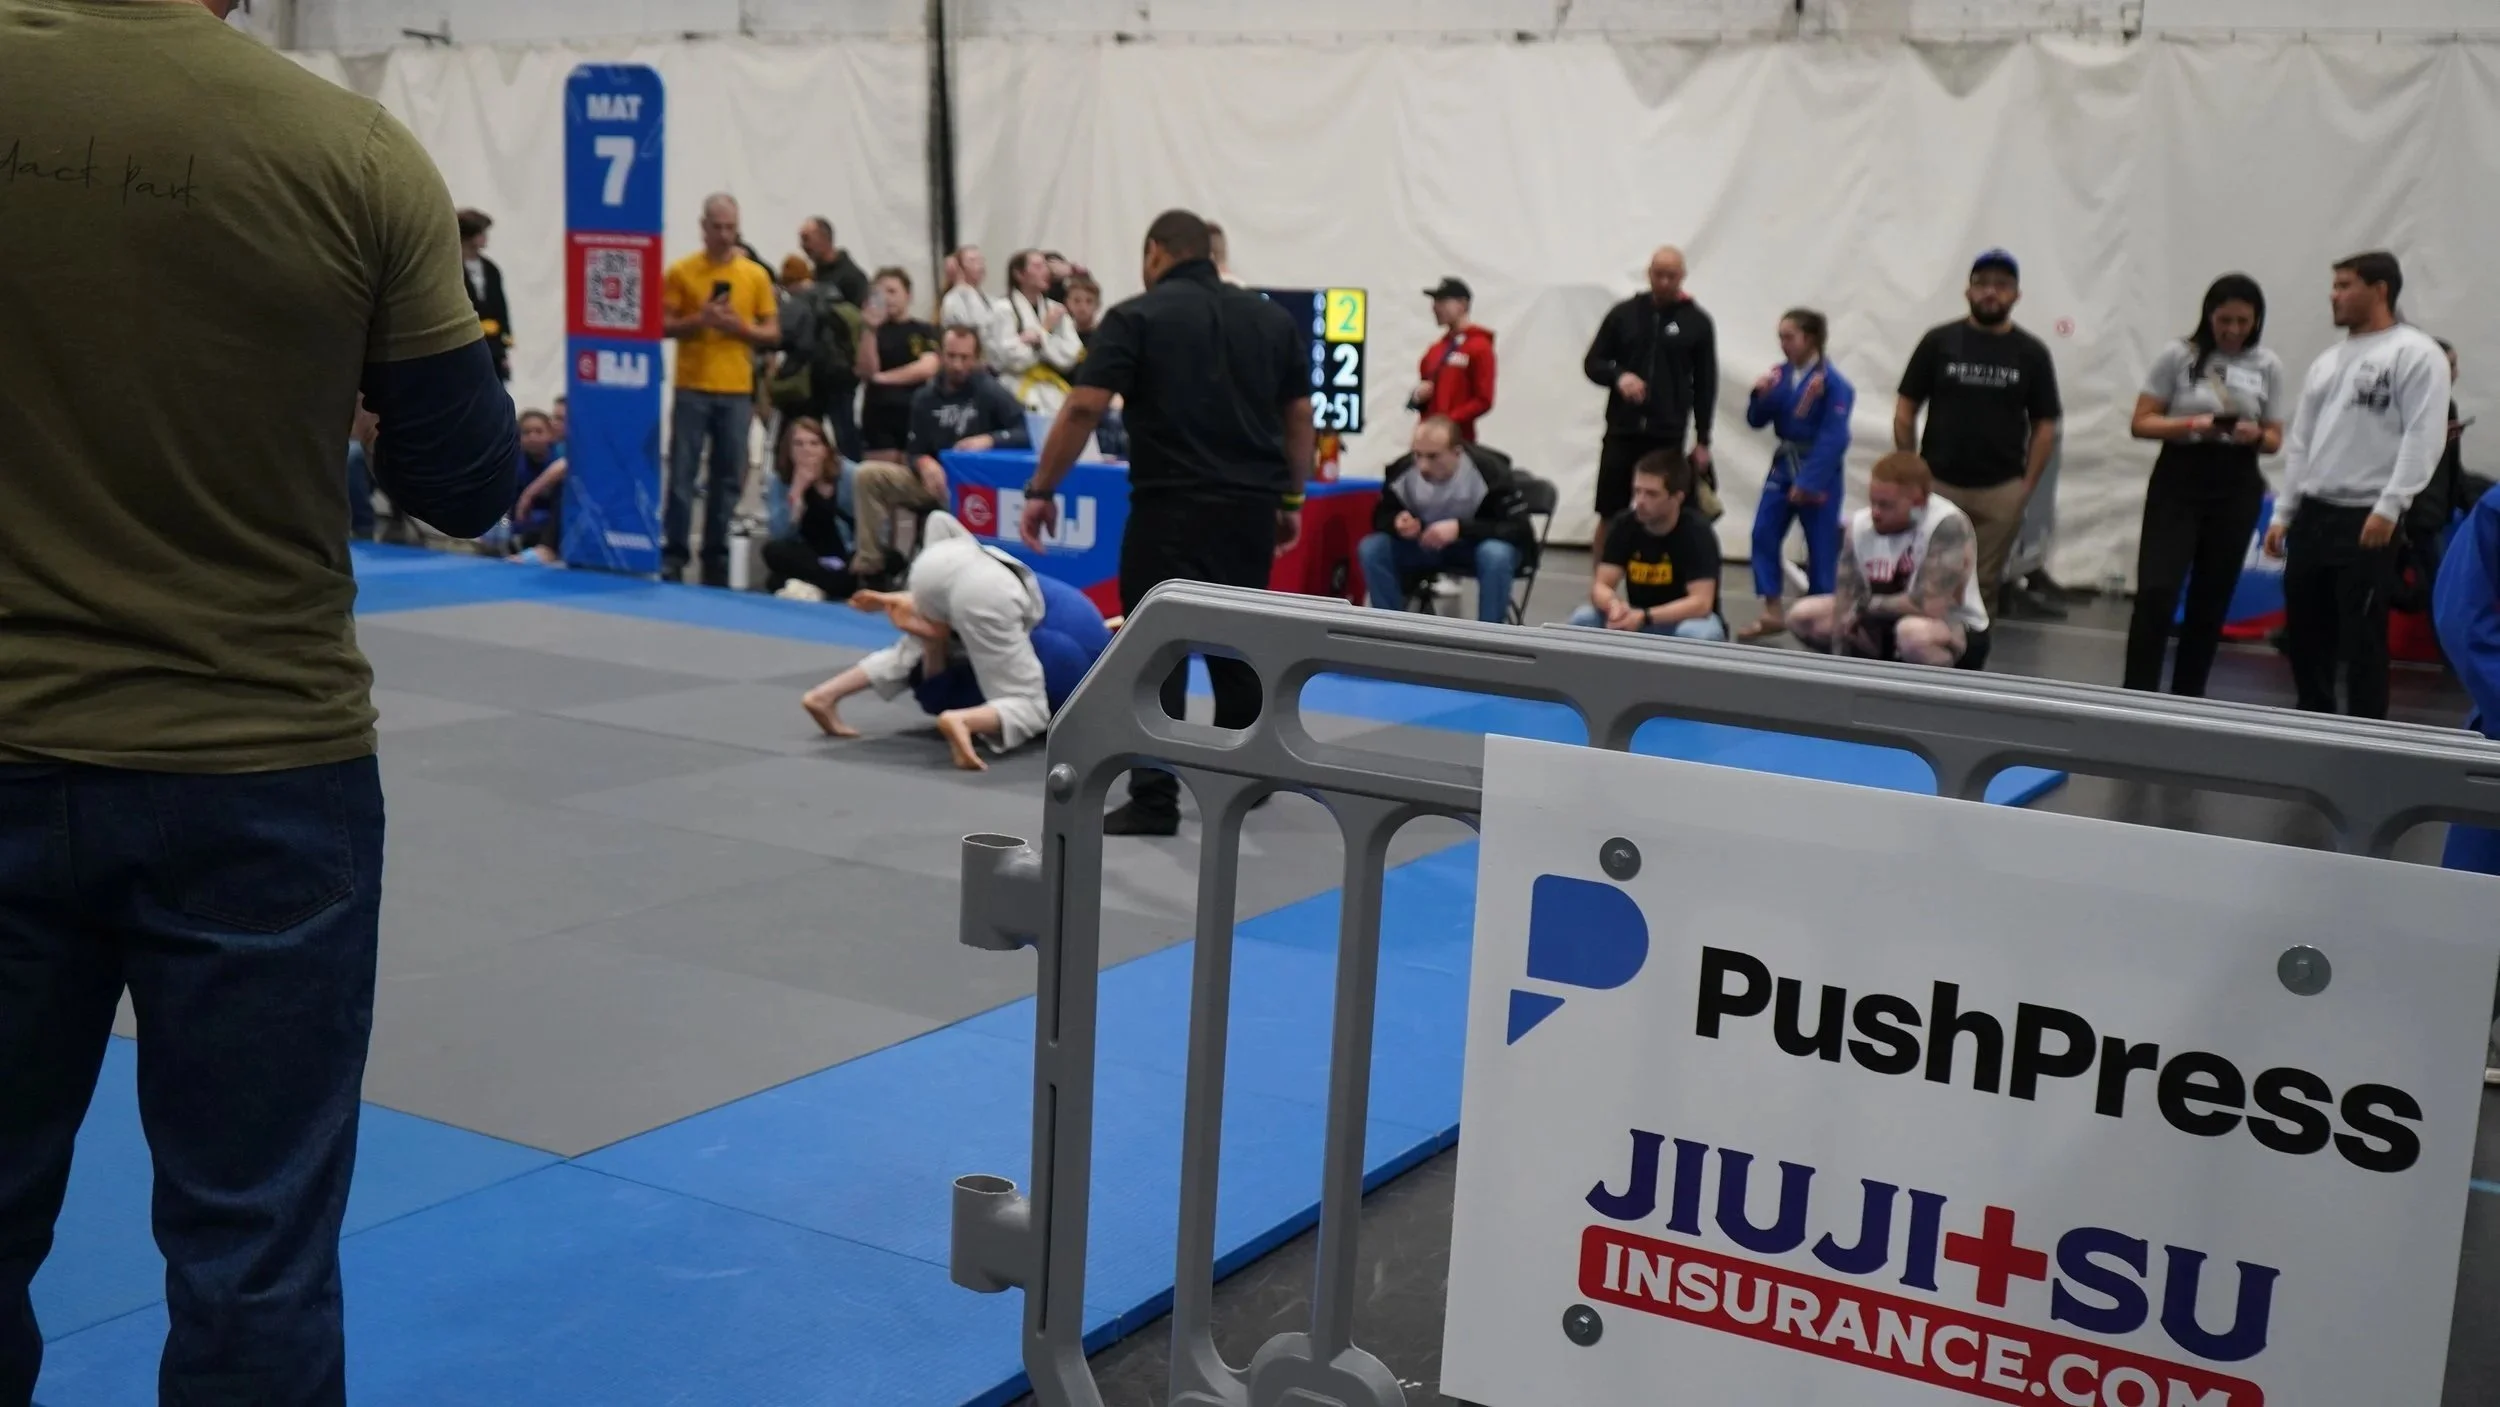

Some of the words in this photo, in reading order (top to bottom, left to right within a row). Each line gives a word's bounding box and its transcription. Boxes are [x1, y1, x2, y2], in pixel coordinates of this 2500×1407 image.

[586, 92, 642, 121] MAT
[594, 134, 635, 207] 7
[1338, 295, 1358, 332] 2
[1332, 342, 1360, 388] 2
[1696, 945, 2424, 1174] PushPress
